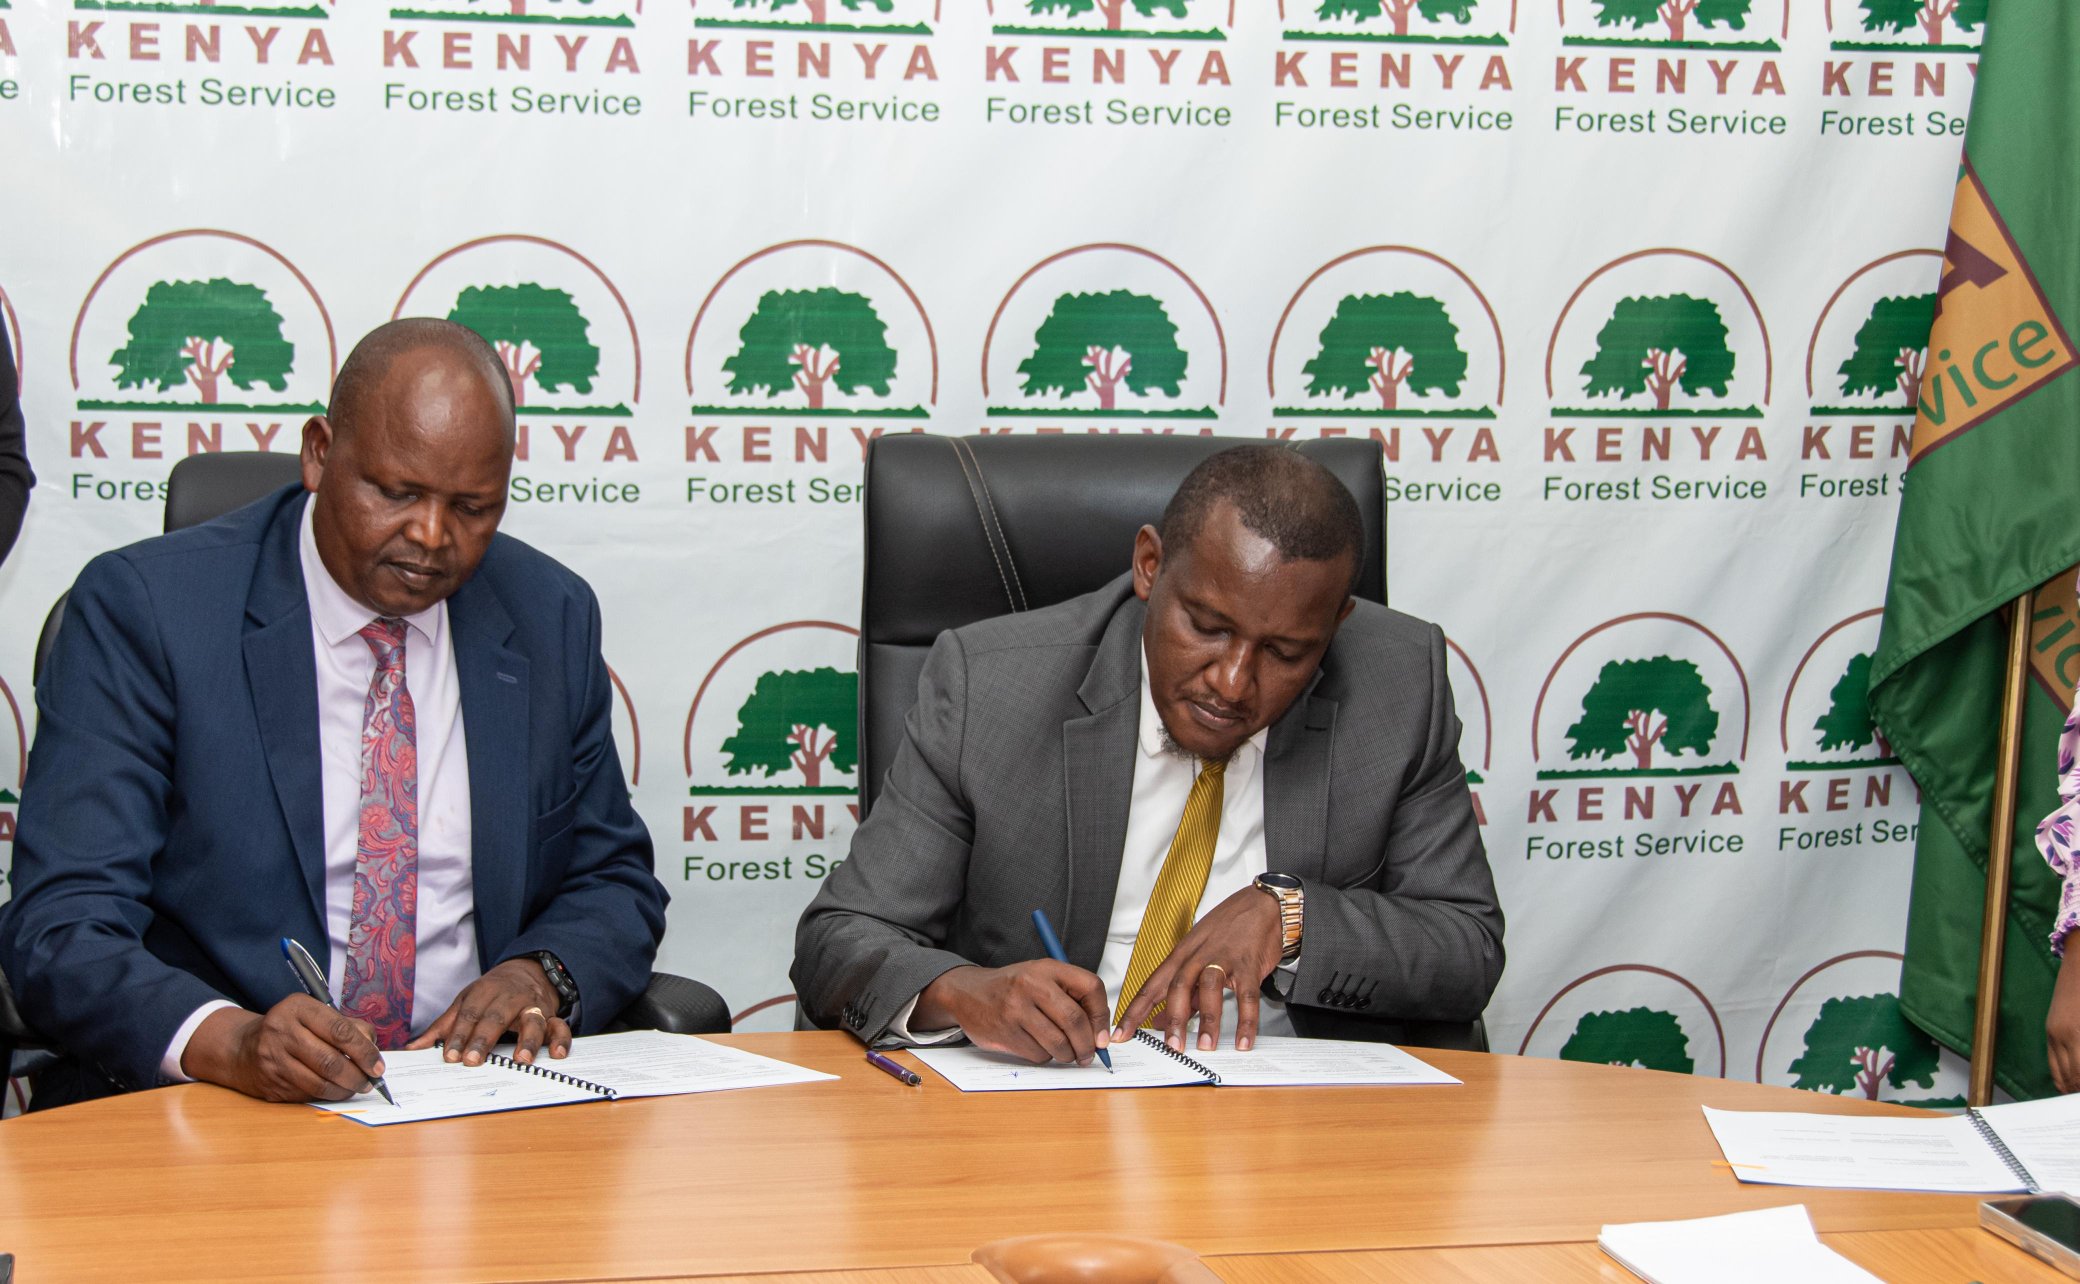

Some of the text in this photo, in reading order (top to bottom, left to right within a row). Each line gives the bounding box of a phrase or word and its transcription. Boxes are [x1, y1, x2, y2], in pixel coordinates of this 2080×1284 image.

[67, 20, 335, 66] KENYA
[383, 30, 641, 74] KENYA
[687, 38, 939, 82] KENYA
[985, 45, 1232, 86] KENYA
[1274, 51, 1513, 91] KENYA
[1554, 56, 1786, 97] KENYA
[1822, 60, 1978, 97] KEN
[69, 74, 337, 109] Forest Service
[384, 82, 642, 116] Forest Service
[688, 90, 940, 122] Forest Service
[986, 96, 1232, 127] Forest Service
[1275, 101, 1514, 131] Forest Service
[1555, 106, 1787, 135] Forest Service
[1820, 109, 1915, 136] Forest
[70, 421, 283, 460] KENY
[684, 426, 926, 464] KENY
[1543, 426, 1768, 464] KENYA
[1801, 424, 1914, 460] KEN
[71, 473, 168, 502] Fores
[510, 476, 642, 504] Service
[686, 477, 797, 505] Forest
[1385, 476, 1502, 503] Service
[1543, 475, 1768, 502] Forest Service
[1800, 472, 1889, 498] Forest
[1527, 780, 1744, 824] KENYA
[1779, 773, 1920, 814] KEN
[683, 804, 861, 842] KEN
[1779, 822, 1864, 851] Forest
[1526, 829, 1745, 861] Forest Service
[684, 855, 794, 882] Forest
